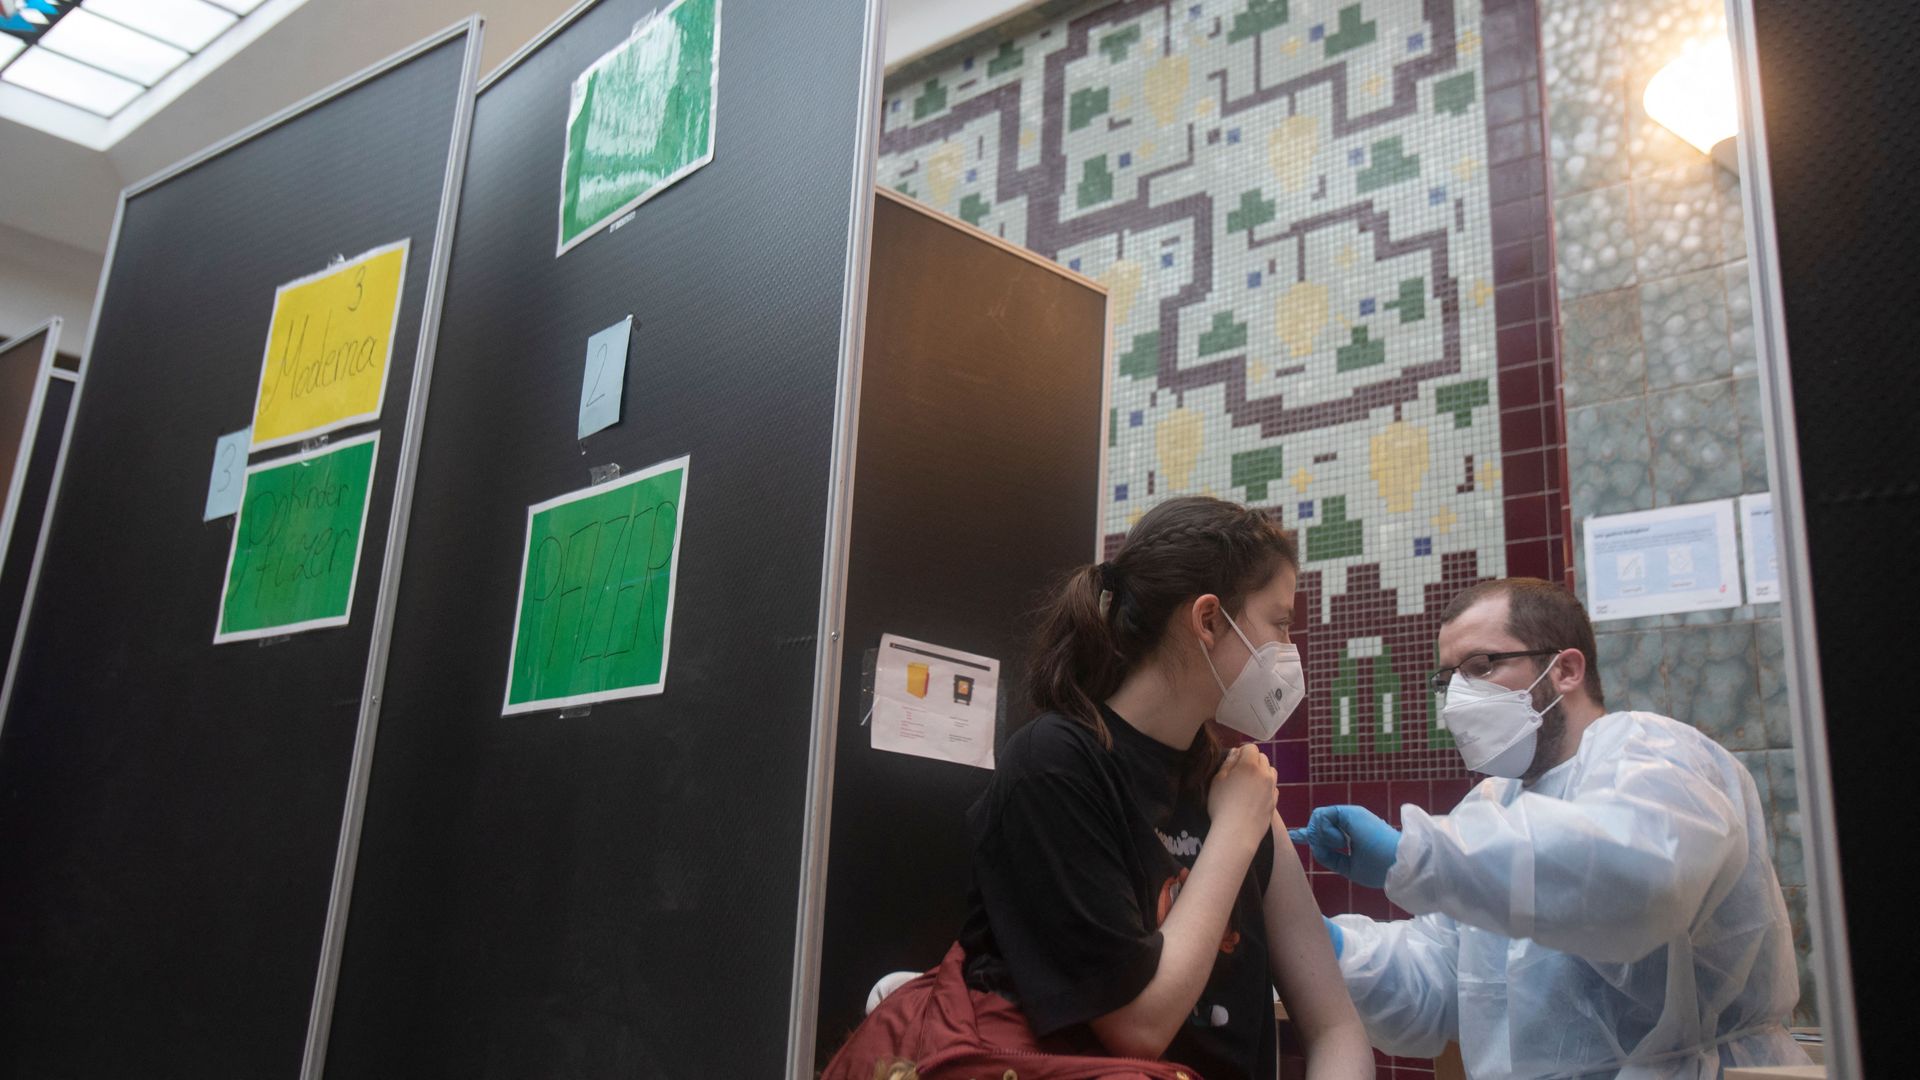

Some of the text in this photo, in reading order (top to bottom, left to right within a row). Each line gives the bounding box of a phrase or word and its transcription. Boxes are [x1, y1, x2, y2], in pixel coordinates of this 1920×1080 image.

[346, 265, 367, 312] 3
[258, 308, 378, 416] Moderna
[585, 343, 608, 408] 2
[216, 443, 237, 493] 3
